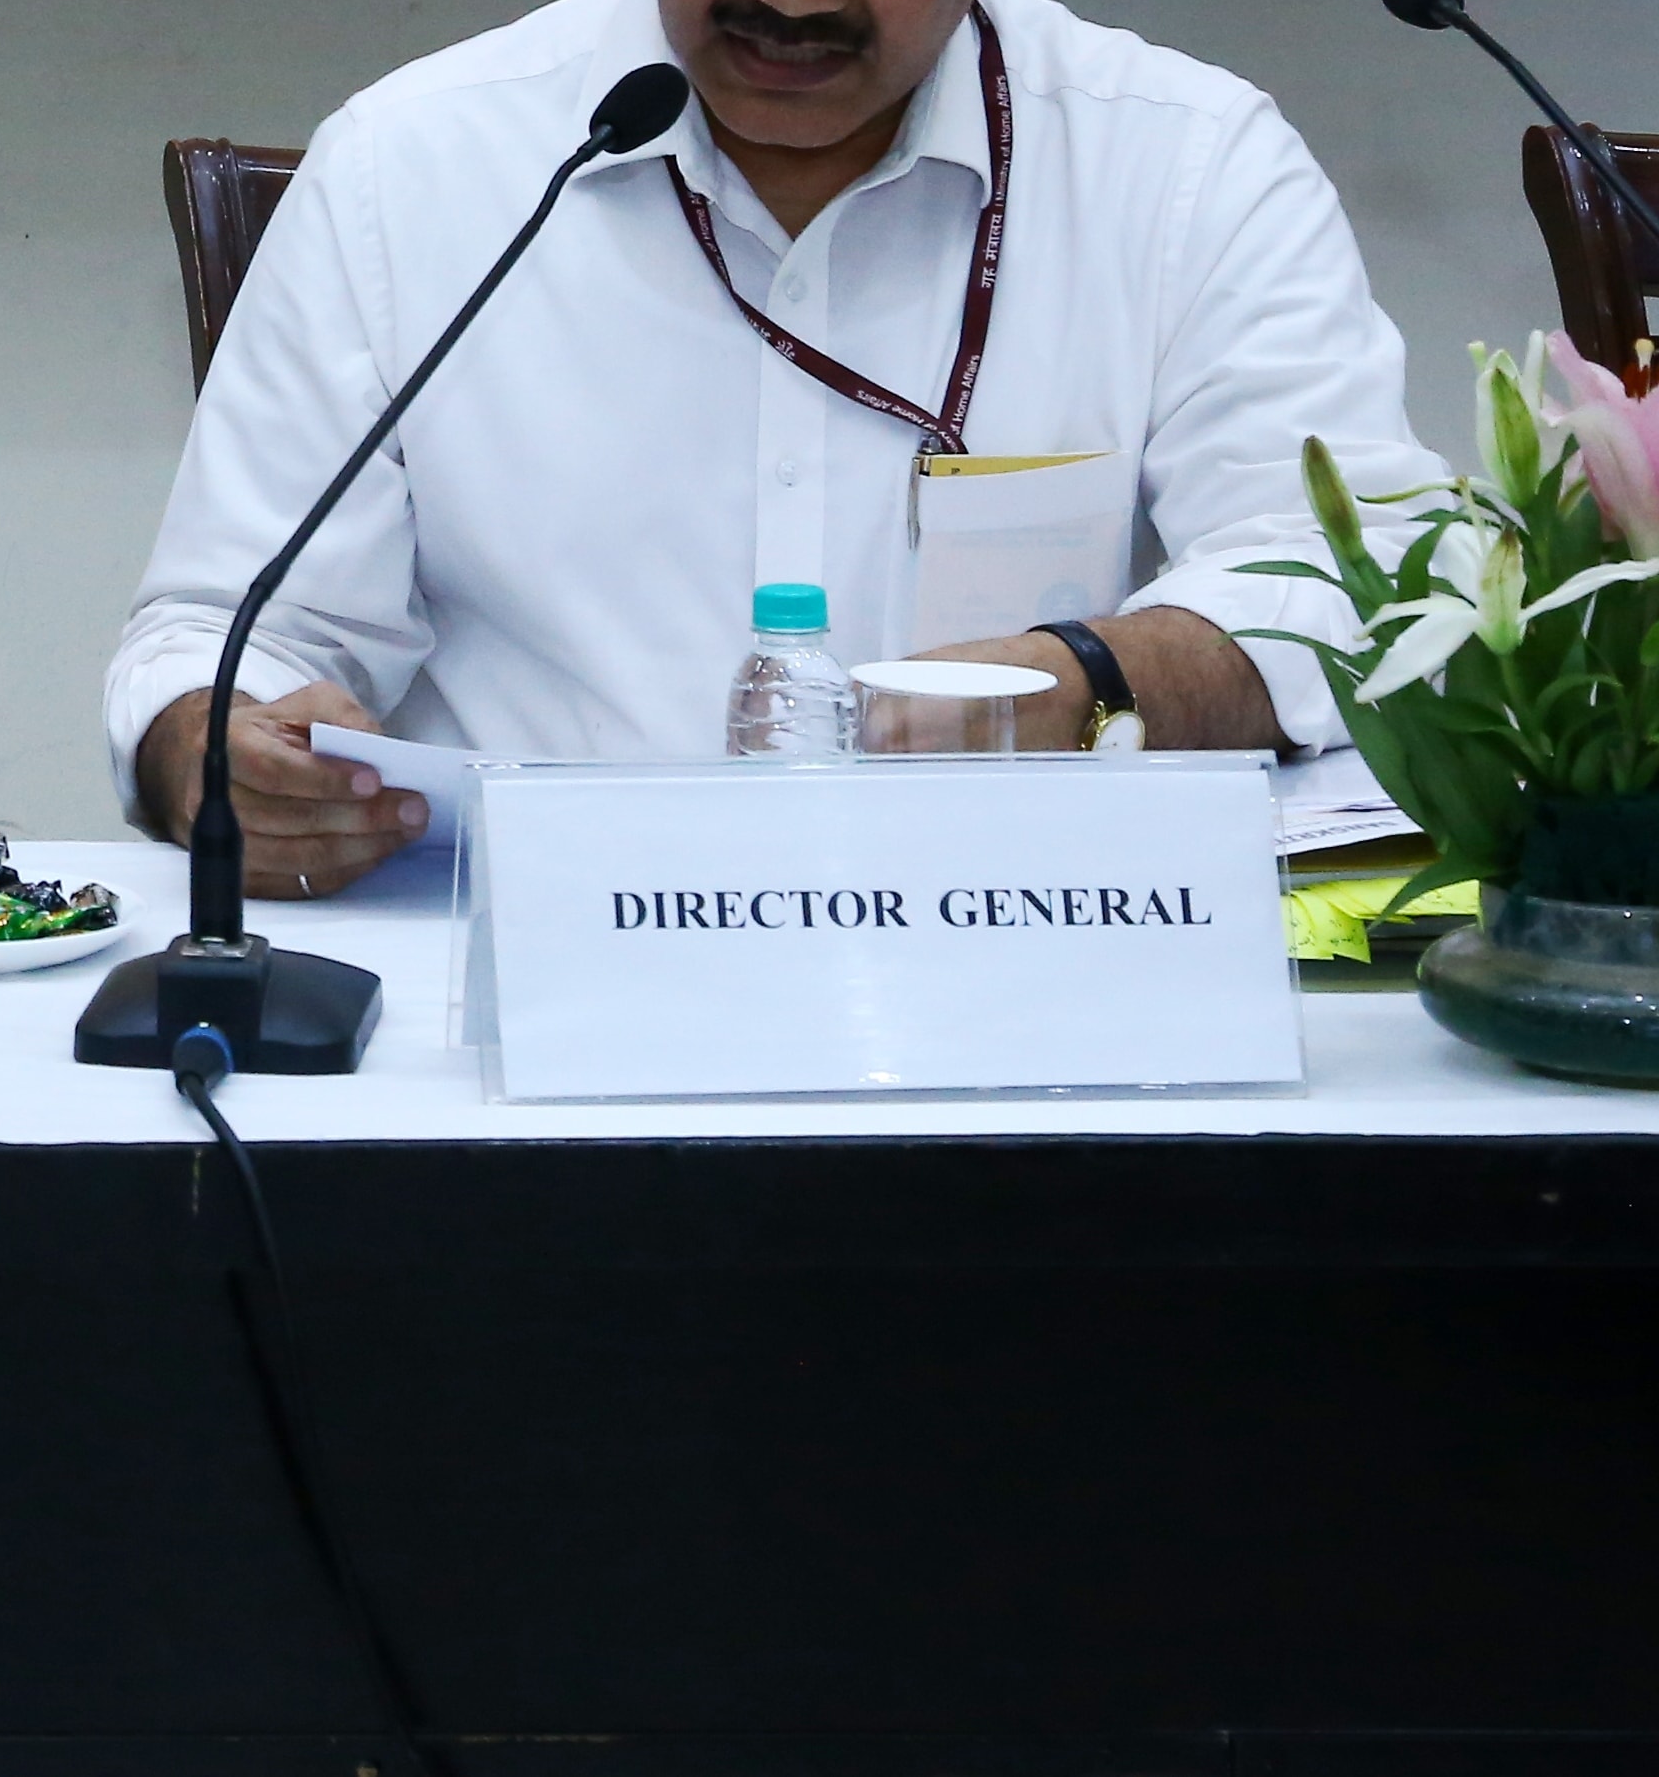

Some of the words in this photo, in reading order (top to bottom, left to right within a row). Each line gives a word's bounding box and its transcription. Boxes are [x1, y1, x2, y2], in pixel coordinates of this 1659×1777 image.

[996, 75, 1011, 107] Affairs
[1000, 110, 1011, 144] Home
[1000, 145, 1010, 157] of
[983, 214, 1003, 261] मंत्रालय
[961, 354, 981, 388] Affairs
[855, 389, 892, 410] Affairs
[891, 402, 925, 424] Home
[952, 390, 971, 422] Home
[609, 888, 912, 931] DIRECTOR
[938, 885, 1214, 928] GENERAL
